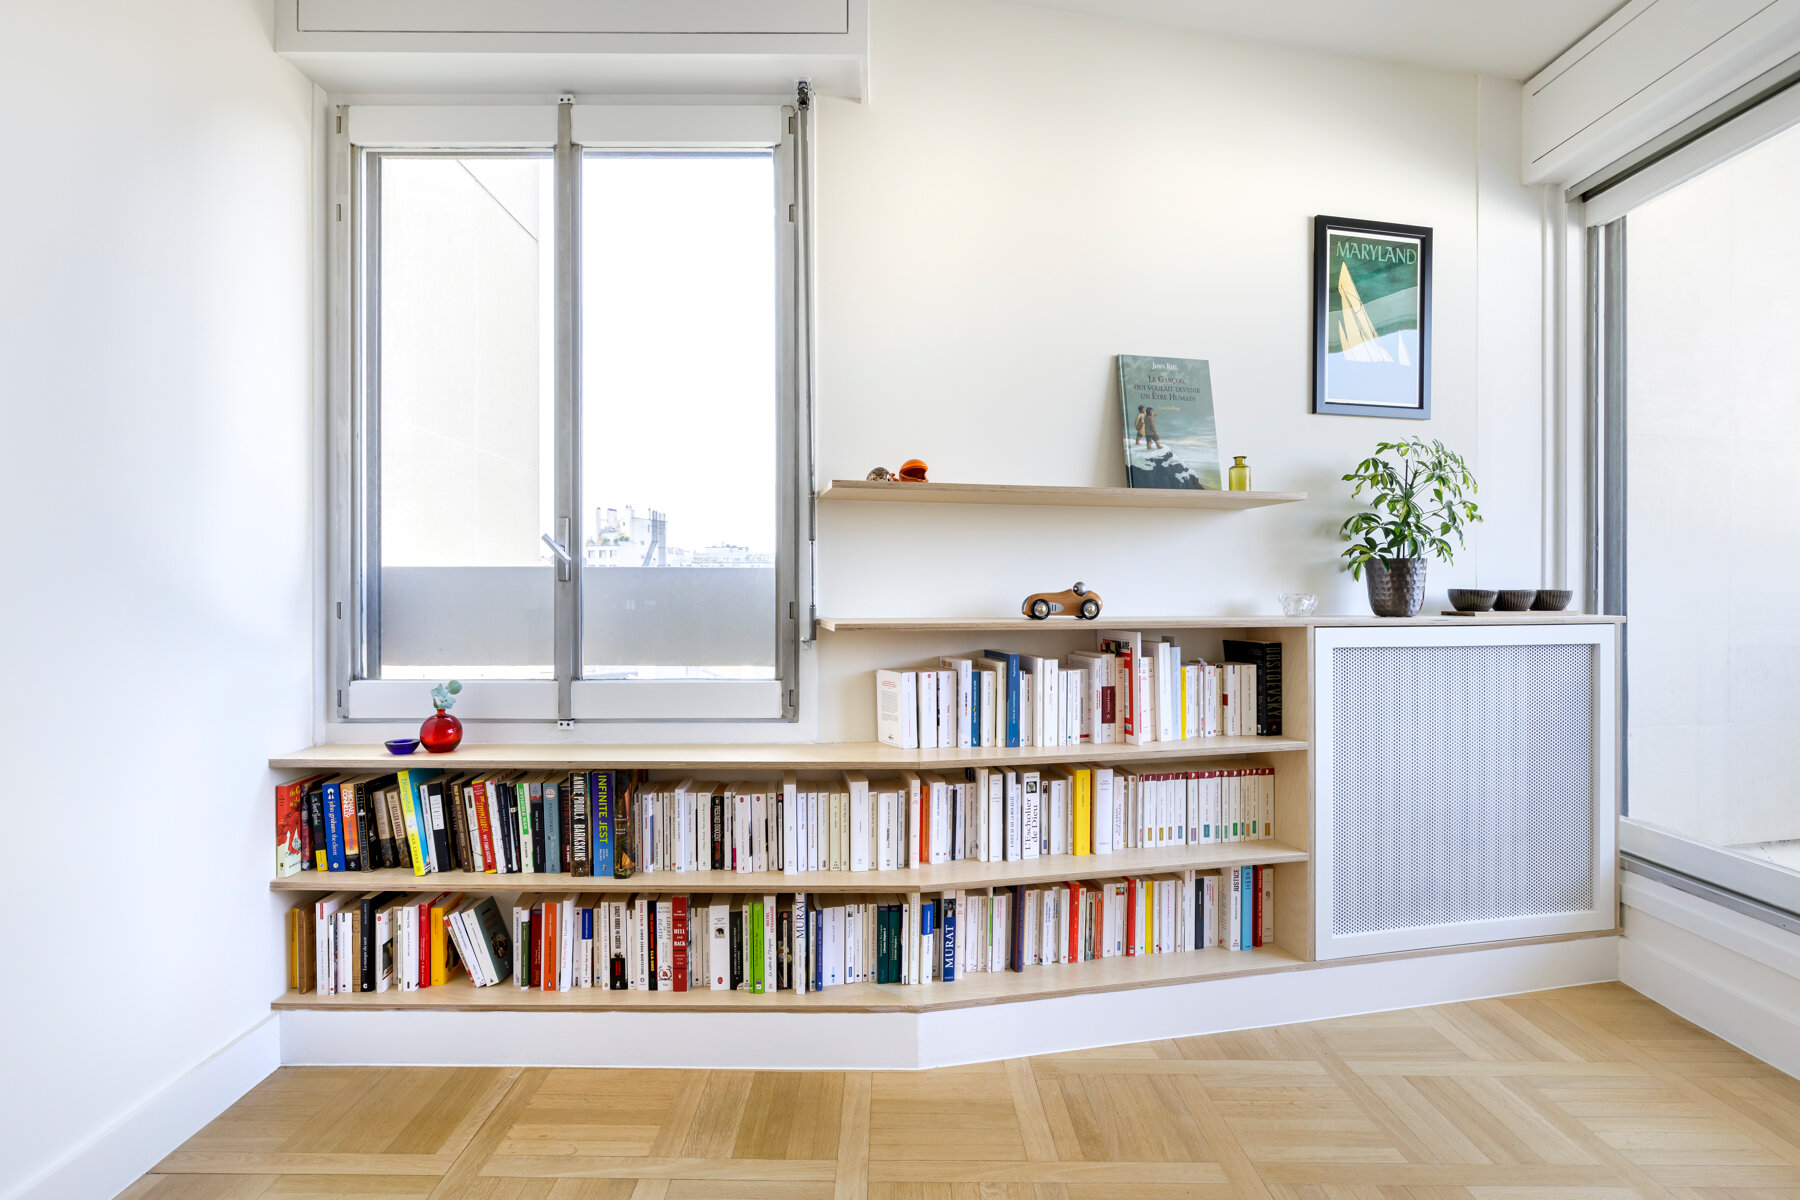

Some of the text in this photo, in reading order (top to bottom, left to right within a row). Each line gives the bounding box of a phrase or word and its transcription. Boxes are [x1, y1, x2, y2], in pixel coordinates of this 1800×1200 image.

[1336, 241, 1417, 264] MARYLAND
[1169, 394, 1196, 402] HUMAIN
[1266, 648, 1282, 716] DOSTOEVSKY
[401, 778, 412, 813] Disrupted
[573, 776, 585, 820] ANNIE PROULX
[598, 775, 608, 843] INFINITE JEST
[574, 824, 585, 861] BARKSKINS
[1032, 830, 1037, 842] de
[796, 899, 804, 939] MURAT
[945, 925, 953, 968] MURAT
